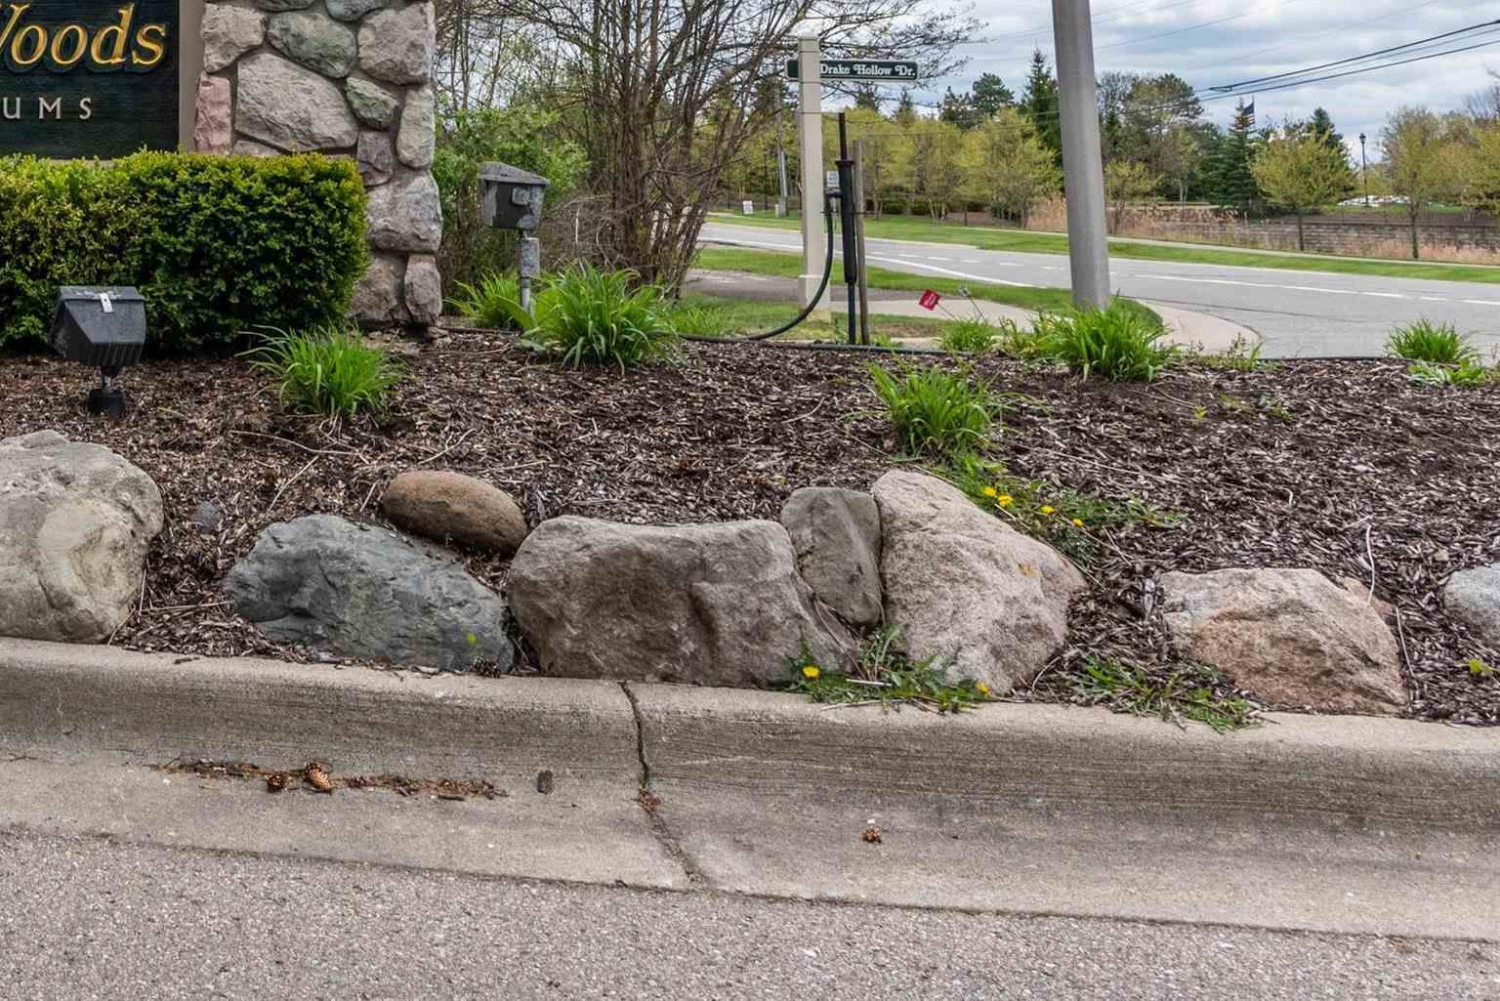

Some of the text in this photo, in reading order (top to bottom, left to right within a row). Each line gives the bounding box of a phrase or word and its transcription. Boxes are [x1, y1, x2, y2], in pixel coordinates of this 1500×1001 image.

[819, 63, 916, 76] Drake Hollow Dr.
